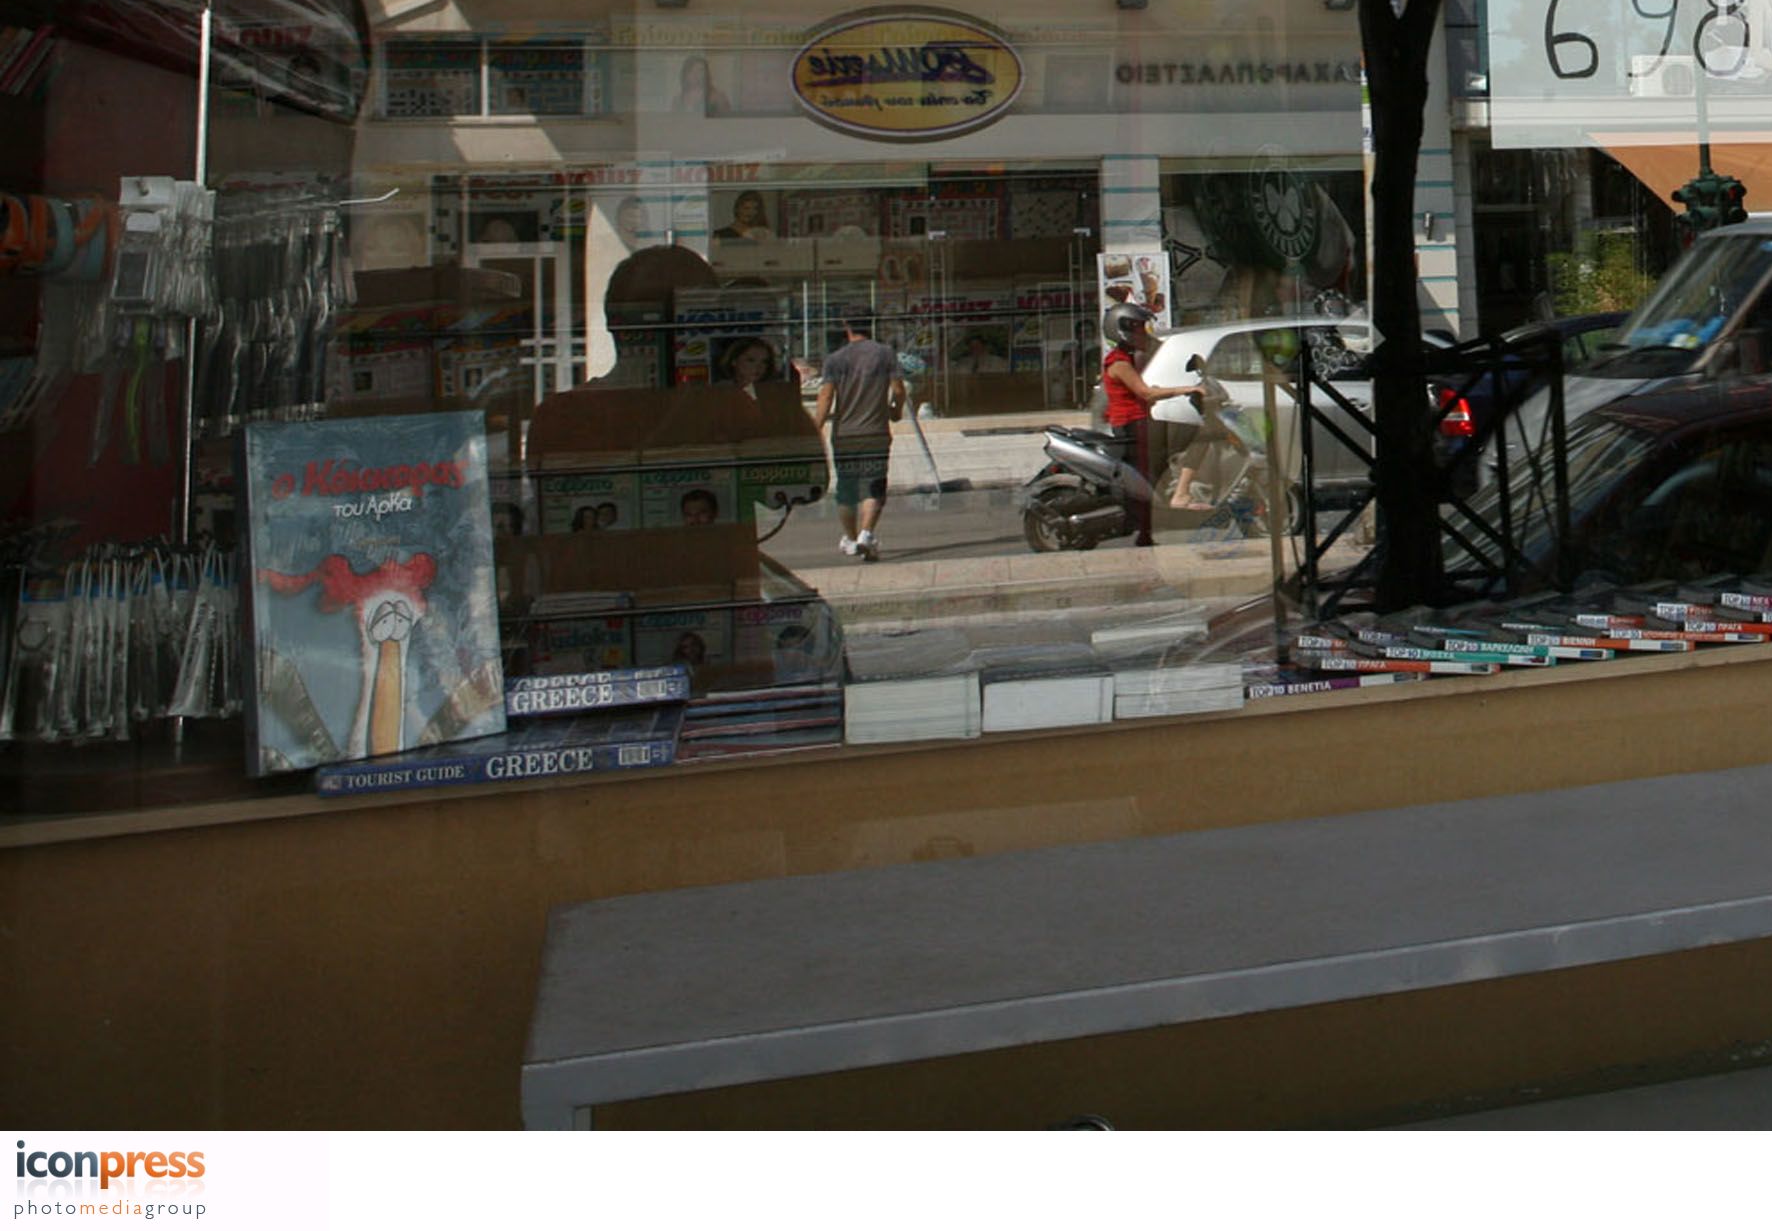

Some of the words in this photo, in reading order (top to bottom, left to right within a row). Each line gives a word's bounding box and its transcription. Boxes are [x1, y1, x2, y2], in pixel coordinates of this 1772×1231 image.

[511, 682, 613, 714] GREECE
[347, 768, 414, 790] TOURIST
[416, 765, 464, 783] GUIDE
[486, 748, 593, 779] GREECE
